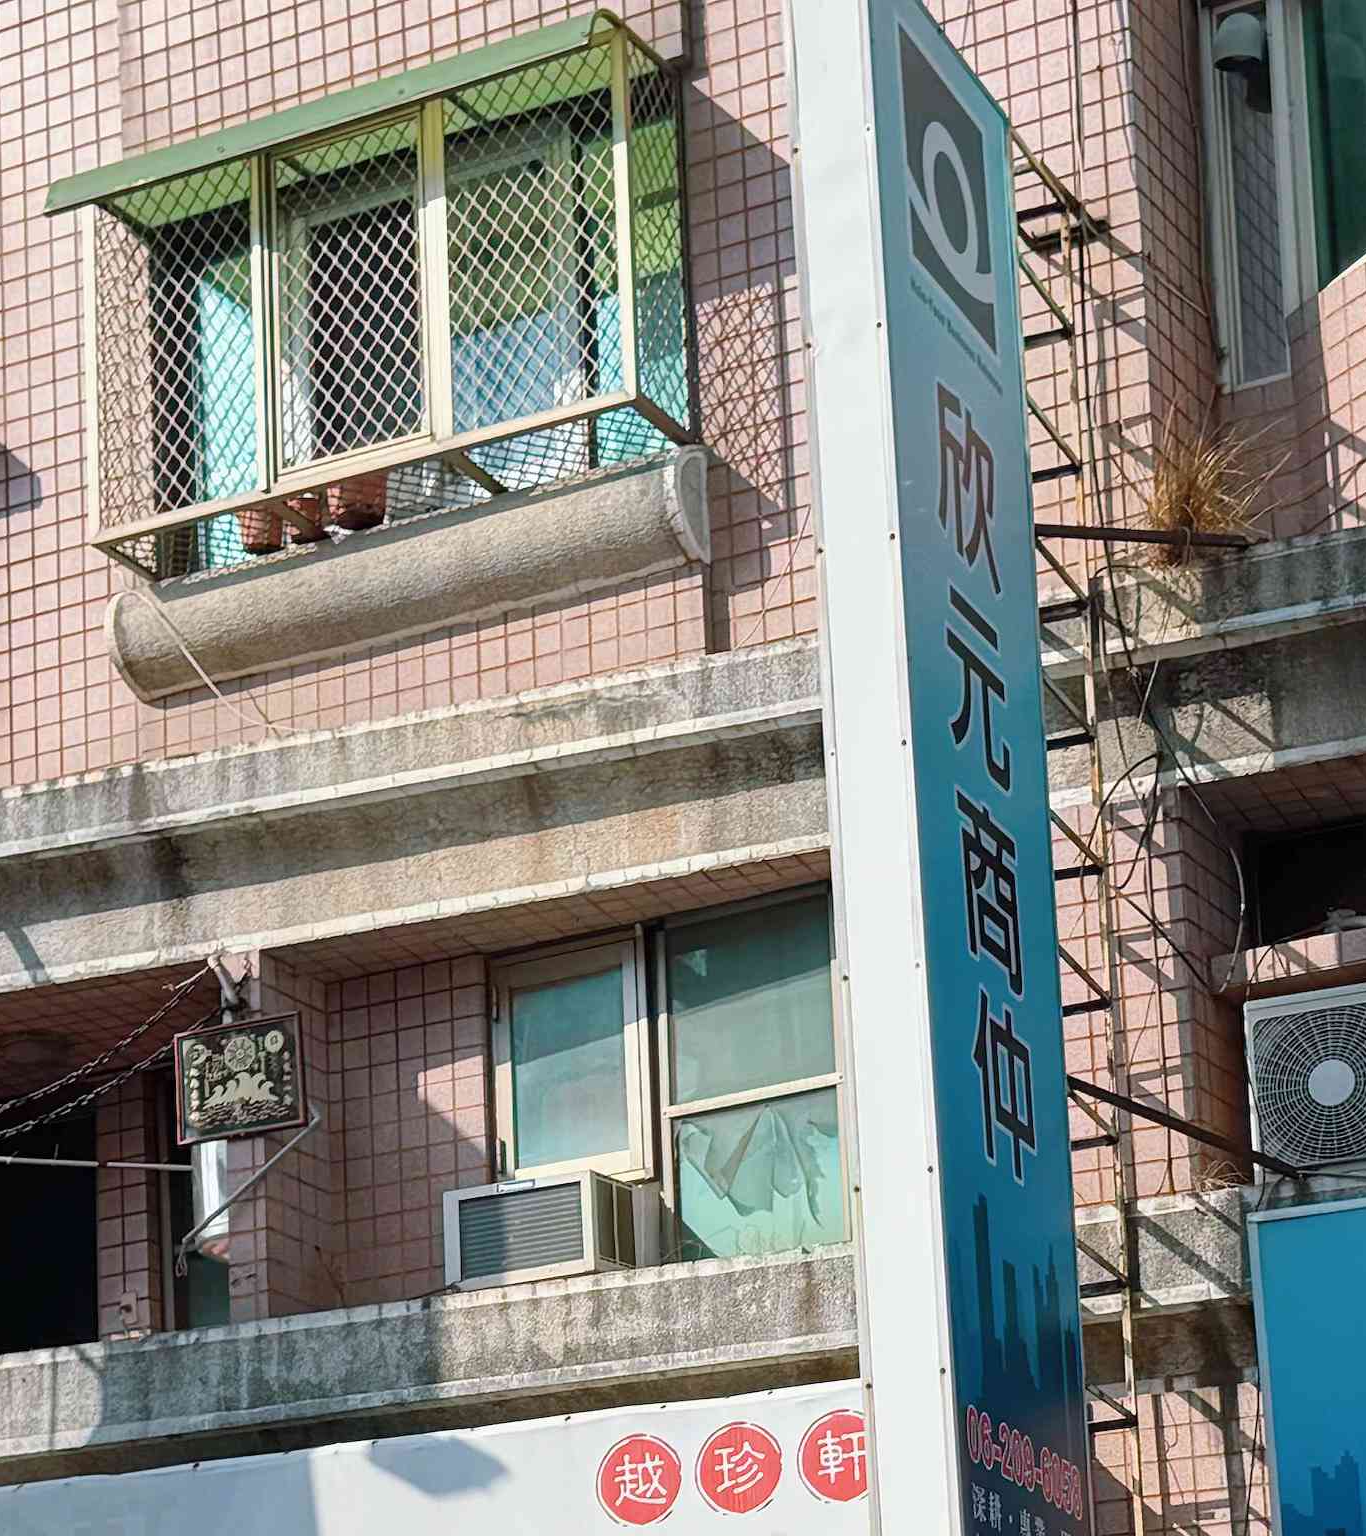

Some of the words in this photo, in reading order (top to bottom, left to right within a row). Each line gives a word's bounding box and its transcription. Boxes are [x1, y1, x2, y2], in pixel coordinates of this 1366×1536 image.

[935, 381, 1038, 1186] 欣元商仲
[609, 1426, 869, 1508] 越珍軒
